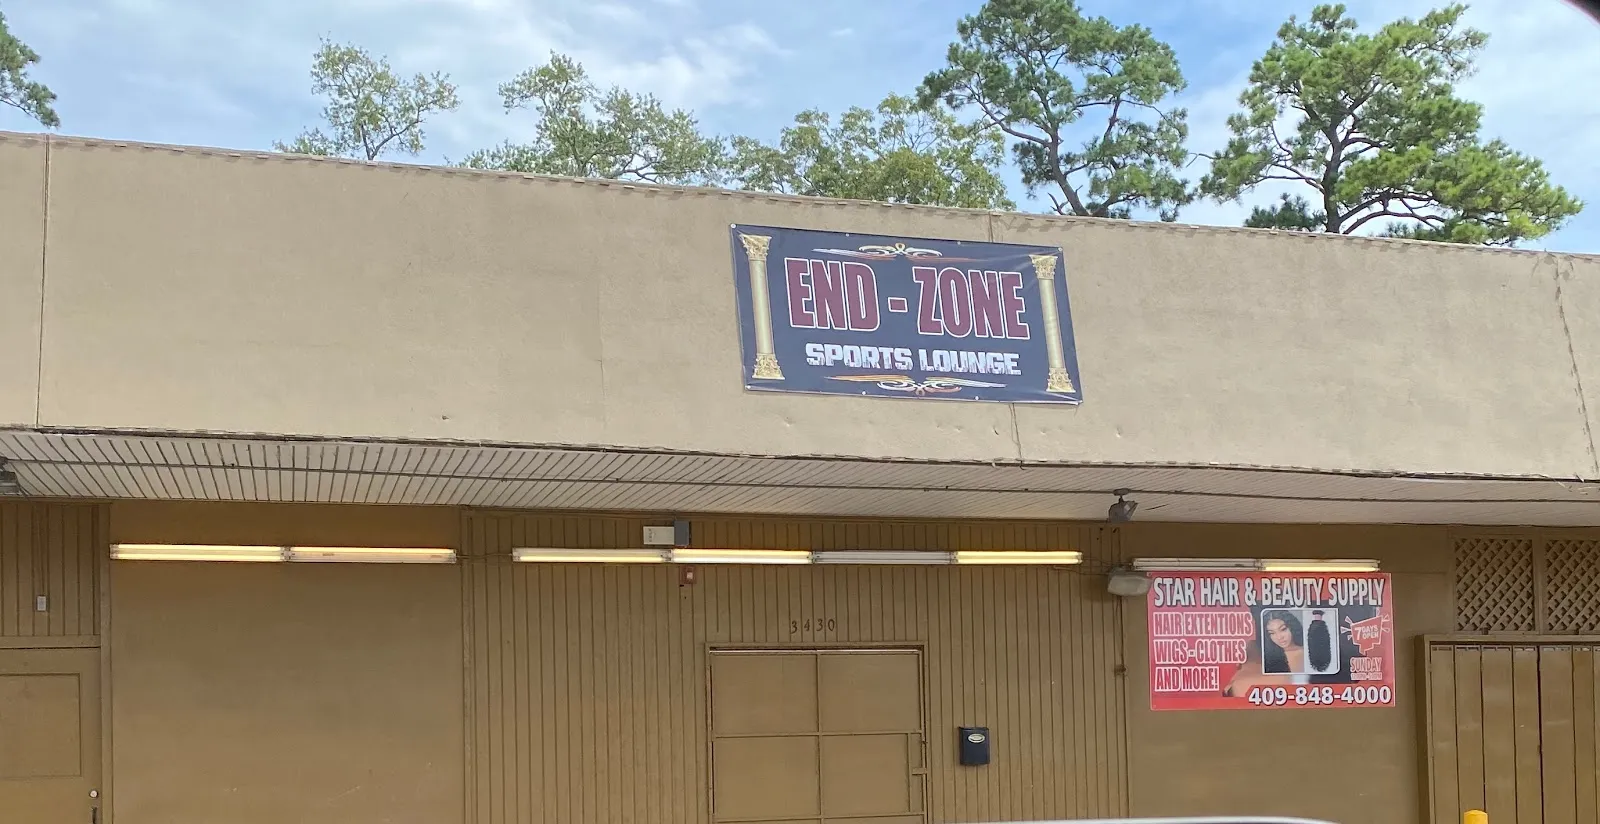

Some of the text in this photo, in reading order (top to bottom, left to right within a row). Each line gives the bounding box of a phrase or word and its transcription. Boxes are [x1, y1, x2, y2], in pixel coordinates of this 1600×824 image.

[784, 257, 880, 332] END
[913, 266, 1031, 340] ZONE
[805, 343, 1022, 375] SPORTS LOUNGE
[1153, 577, 1385, 607] STAR HAIR & BEAUTY SUPPLY
[791, 618, 836, 635] 3430
[1153, 612, 1253, 637] HAIR EXTENTIONS
[1355, 626, 1362, 640] 7
[1361, 625, 1378, 633] DAYS
[1362, 632, 1379, 640] OPEN
[1350, 656, 1383, 673] SUNDAY
[1155, 666, 1220, 692] AND MORE!
[1248, 686, 1391, 706] 409-848-4000
